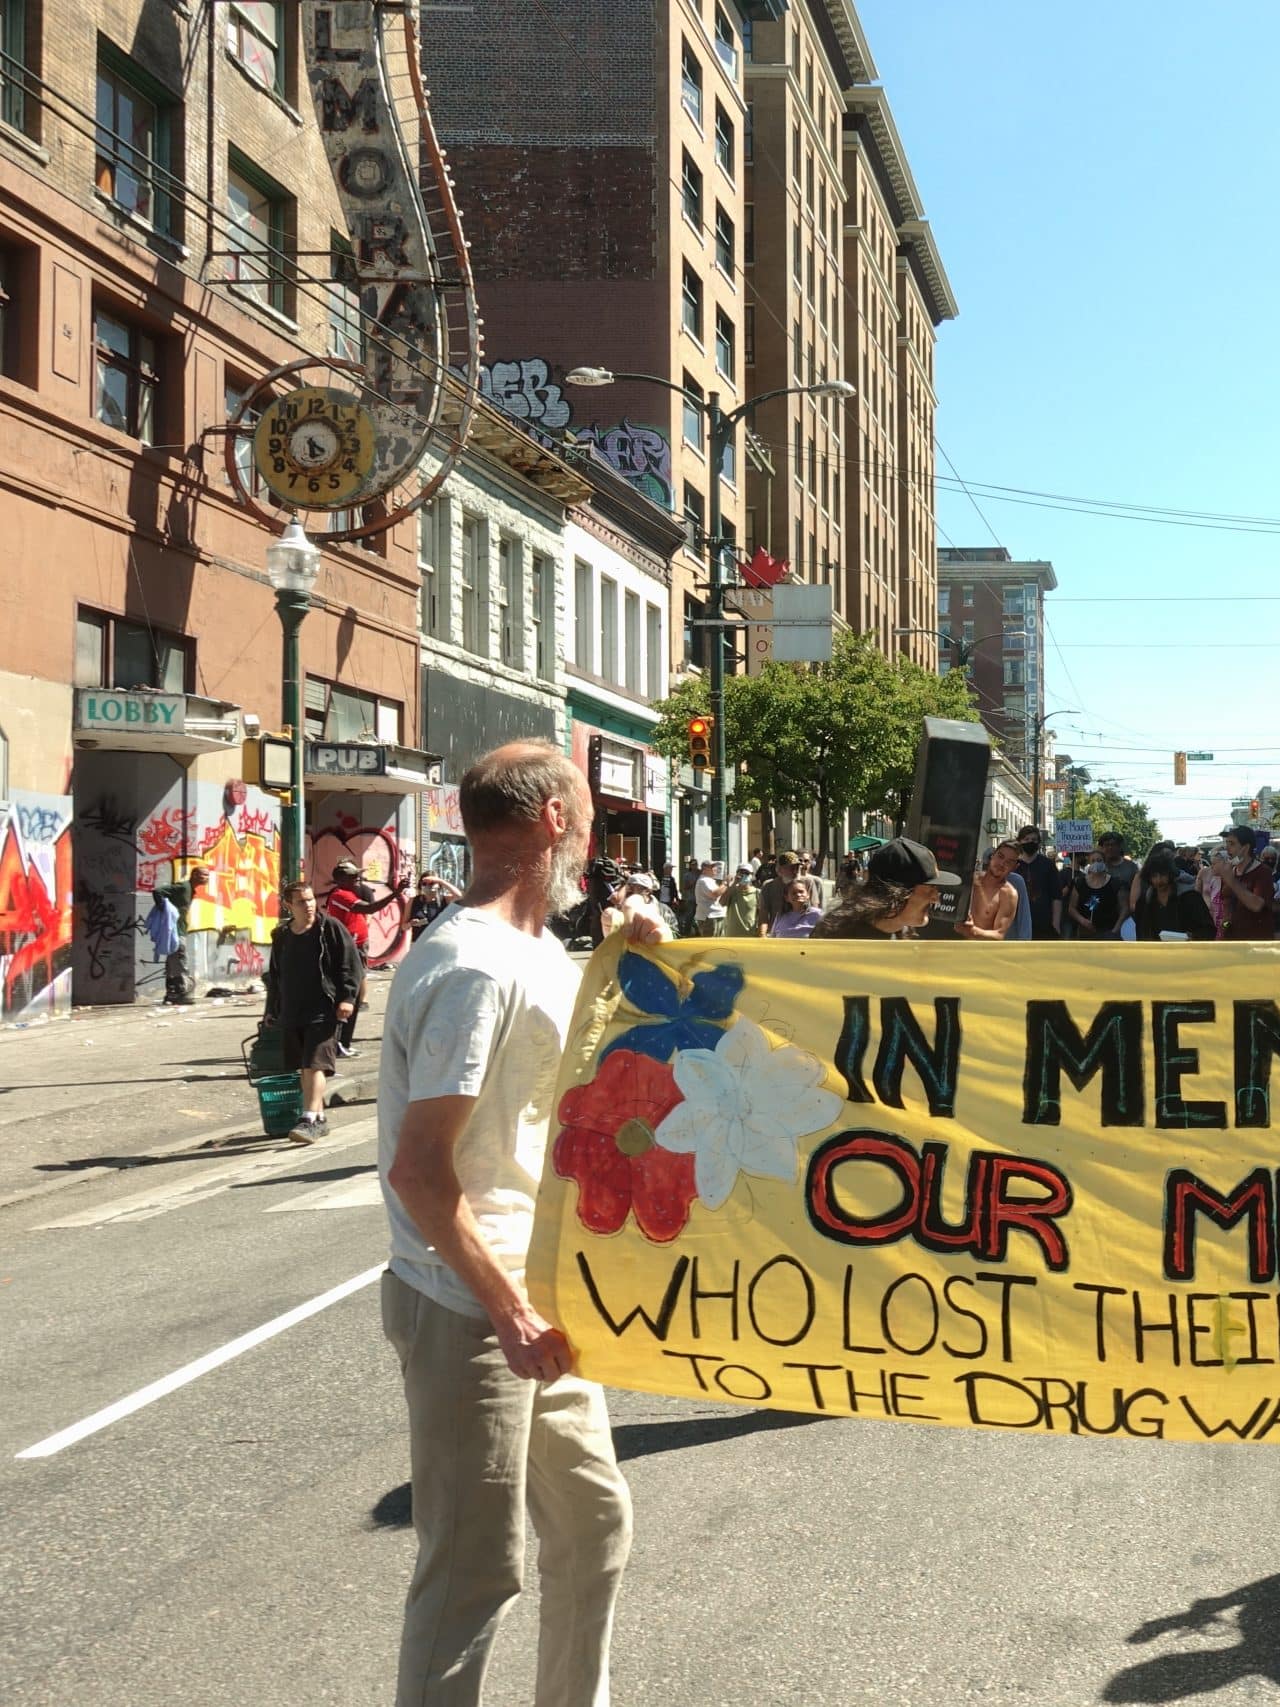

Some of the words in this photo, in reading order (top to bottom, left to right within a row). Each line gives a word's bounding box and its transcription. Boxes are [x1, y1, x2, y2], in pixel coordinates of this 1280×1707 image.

[1026, 596, 1037, 682] HOTEL
[88, 698, 178, 725] LOBBY
[317, 747, 378, 770] PUB
[933, 903, 956, 912] Poor
[834, 995, 961, 1118] IN
[804, 1127, 1074, 1272] OUR
[576, 1251, 815, 1348] WHO
[843, 1264, 1037, 1362] LOST
[662, 1349, 773, 1401] TO
[783, 1361, 944, 1419] THE
[954, 1371, 1168, 1439] DRUG
